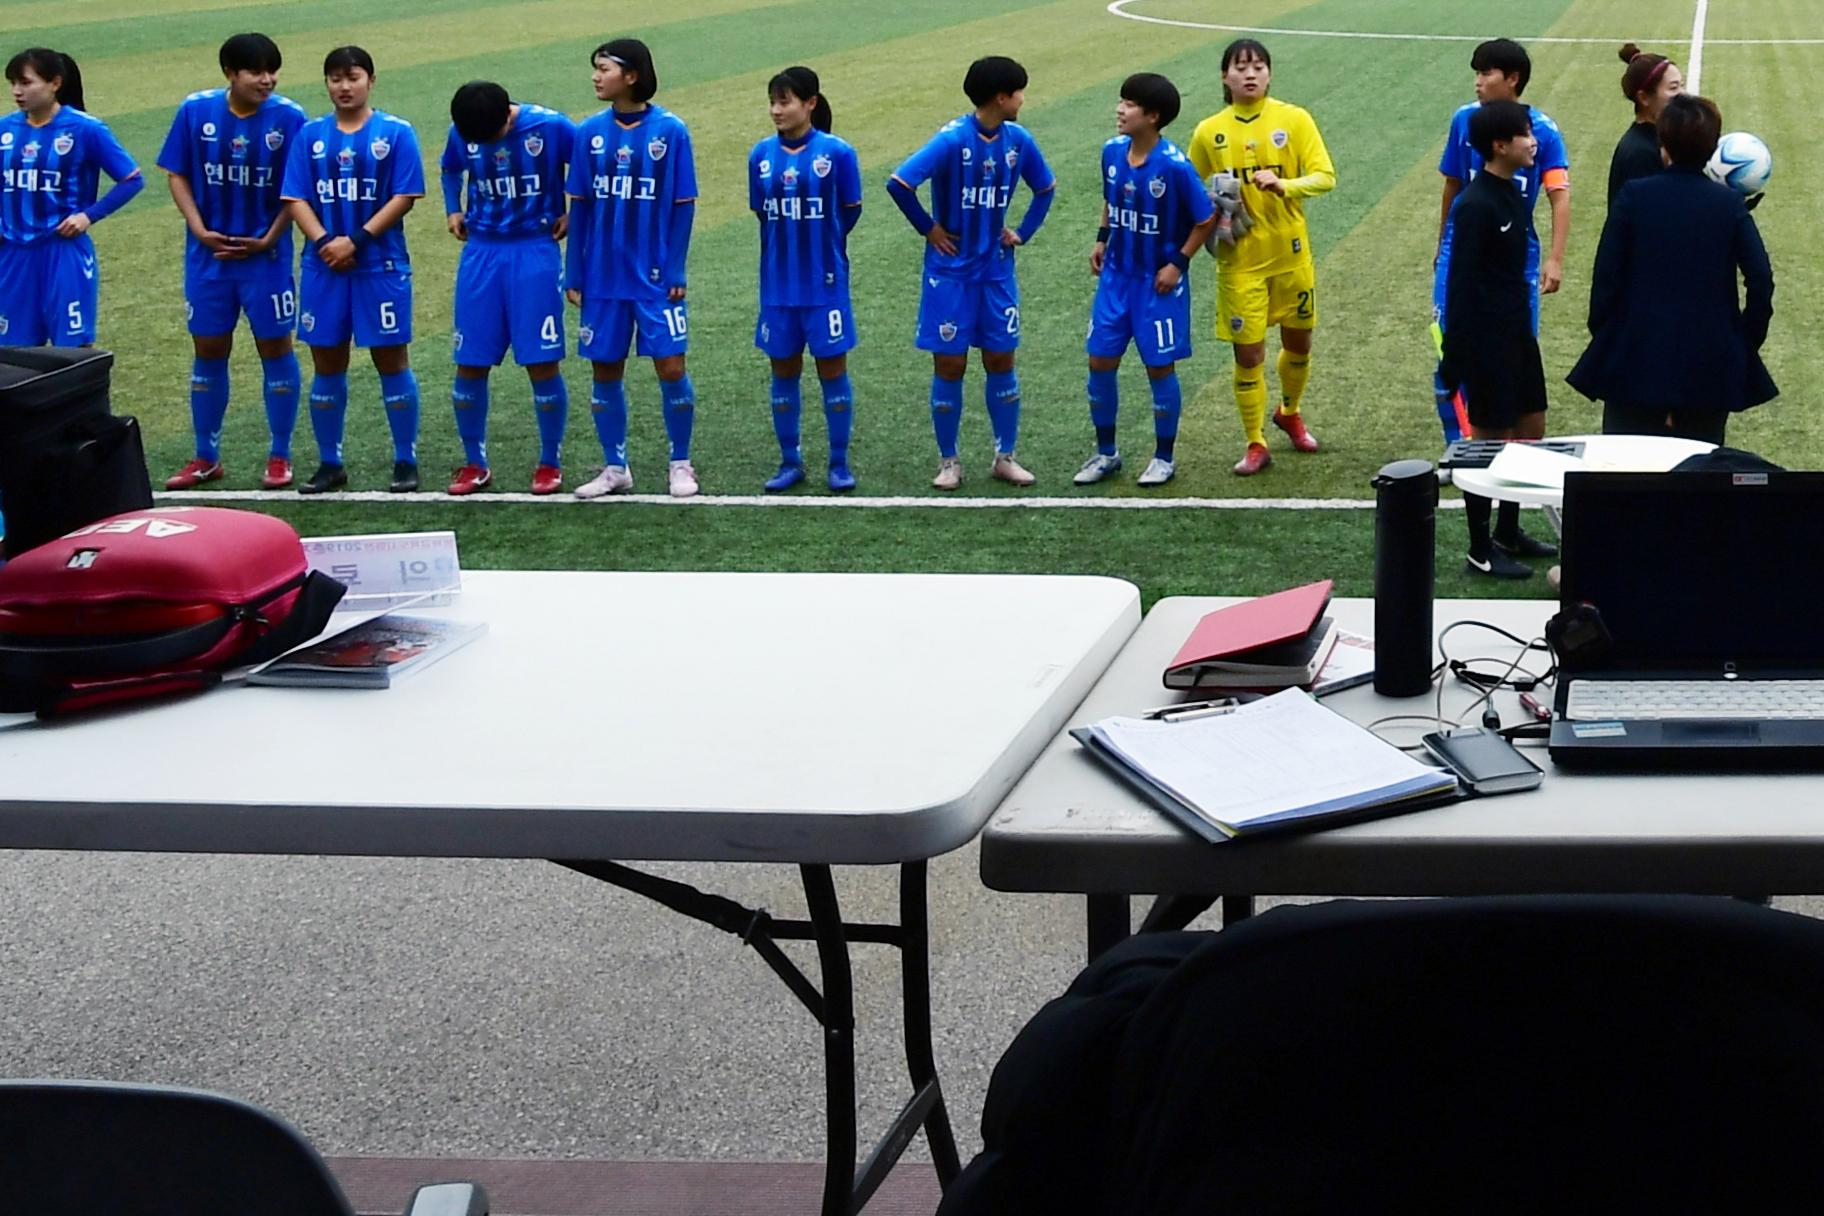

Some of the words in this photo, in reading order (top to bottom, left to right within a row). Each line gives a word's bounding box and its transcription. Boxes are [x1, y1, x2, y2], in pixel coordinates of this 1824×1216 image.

[203, 160, 273, 188] 현대고
[477, 173, 542, 201] 현대고
[592, 174, 656, 201] 현대고
[316, 177, 377, 204] 현대고
[961, 184, 1010, 210] 현대고
[763, 195, 825, 221] 현대고
[1108, 202, 1160, 236] 현대고
[68, 301, 82, 329] 5
[271, 290, 295, 319] 18
[380, 302, 396, 329] 6
[541, 315, 558, 342] 4
[663, 306, 687, 336] 16
[828, 309, 842, 336] 8
[1154, 318, 1174, 347] 11
